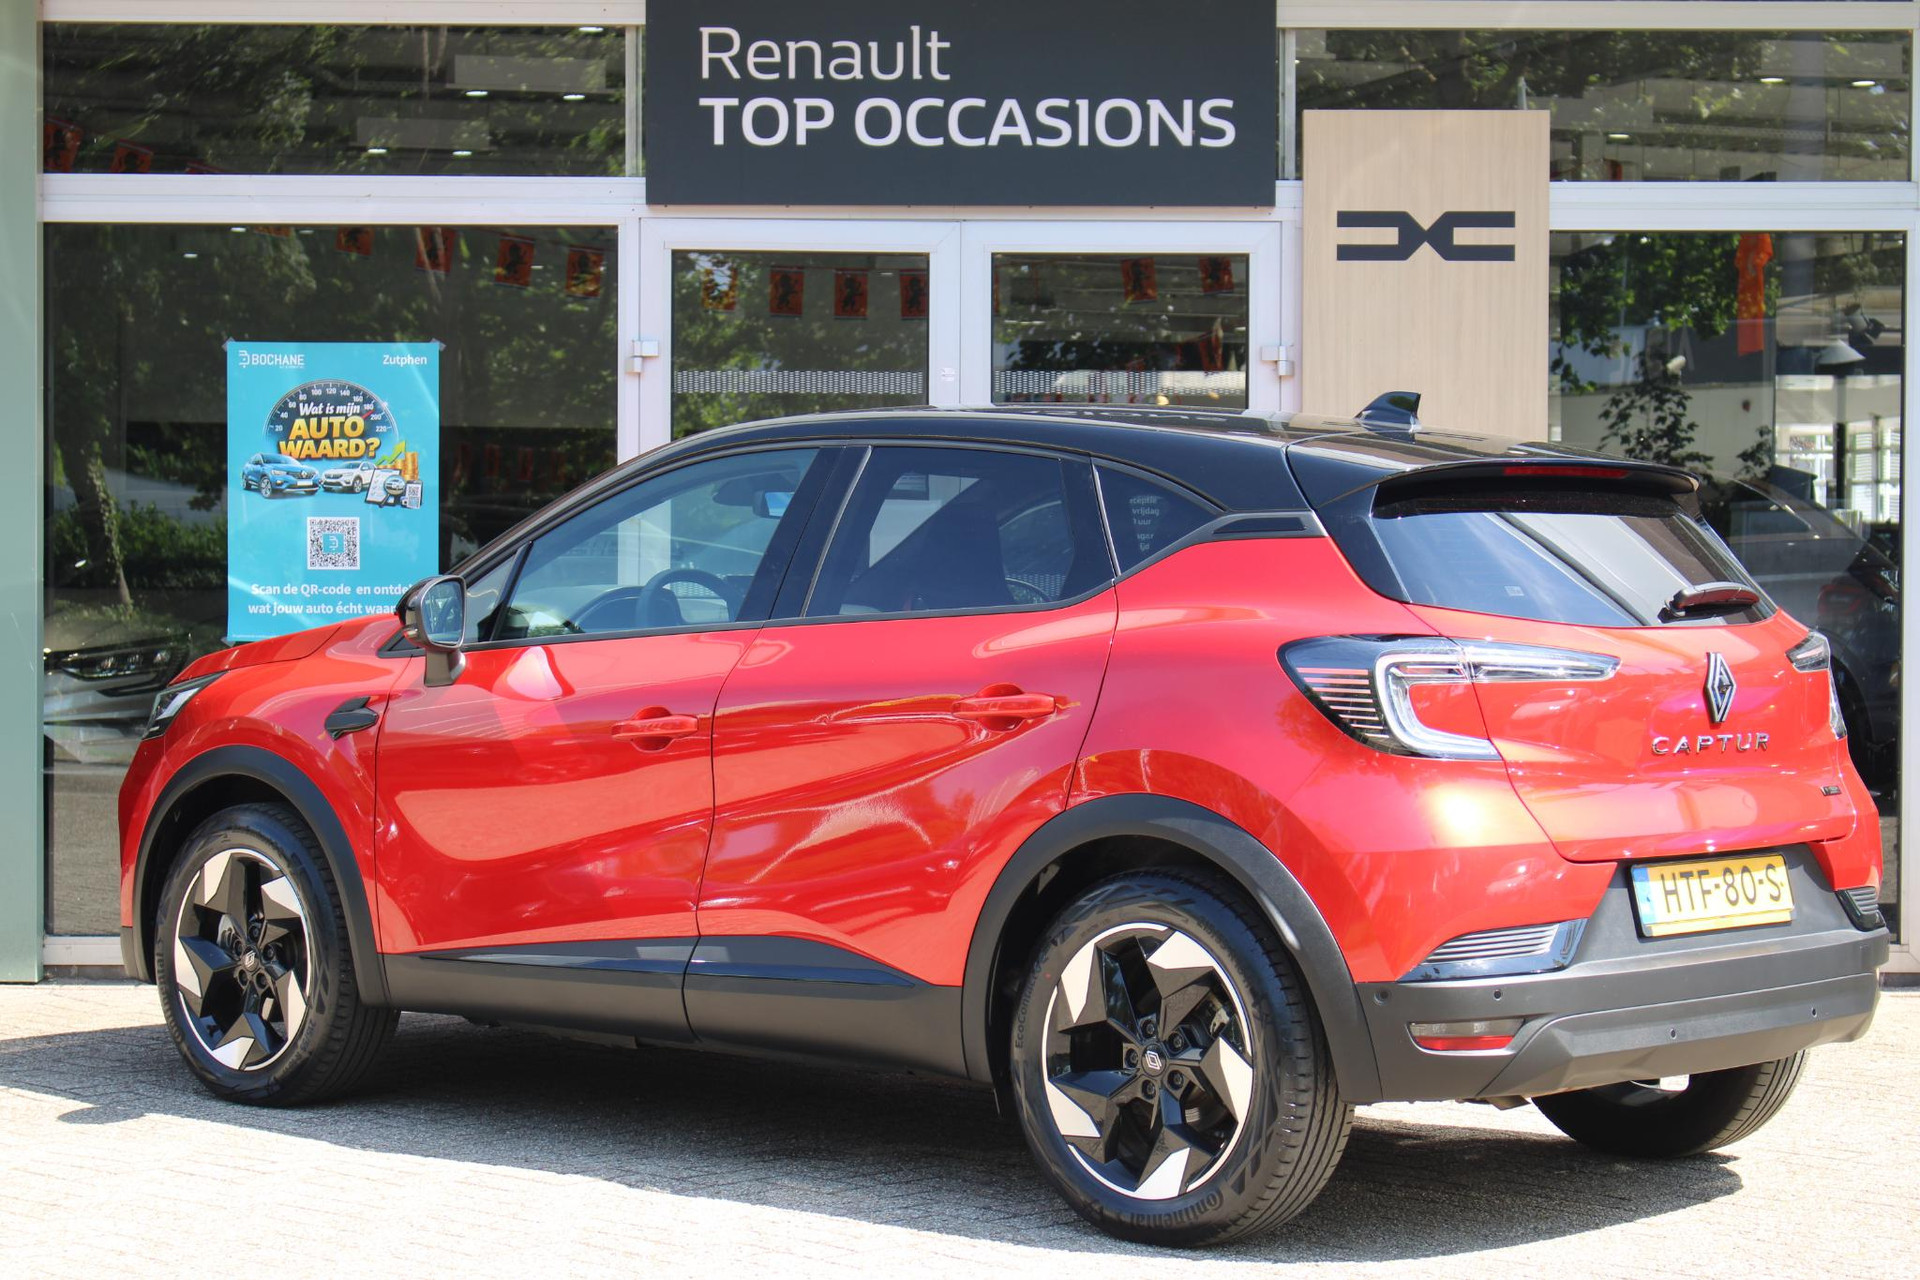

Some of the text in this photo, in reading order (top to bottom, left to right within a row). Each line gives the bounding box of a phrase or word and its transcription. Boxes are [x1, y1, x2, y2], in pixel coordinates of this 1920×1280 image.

[699, 25, 951, 81] Renault
[699, 97, 1236, 147] TOP OCCASIONS
[251, 353, 305, 366] BOCHANE
[383, 353, 428, 368] Zutphen
[275, 387, 387, 433] 20 40 60 80 100 120 140 160 180 200 220
[299, 402, 361, 417] Wat is mijn
[289, 415, 365, 440] AUTO
[279, 437, 381, 459] WAARD?
[251, 582, 413, 597] Scan de QR-code en ontde
[248, 603, 271, 614] wat
[272, 601, 303, 616] jouw
[306, 603, 334, 614] auto
[335, 600, 363, 614] écht
[1651, 732, 1769, 755] CAPTUR
[1660, 863, 1782, 914] HTF-80-S
[1129, 1188, 1224, 1229] Continental
